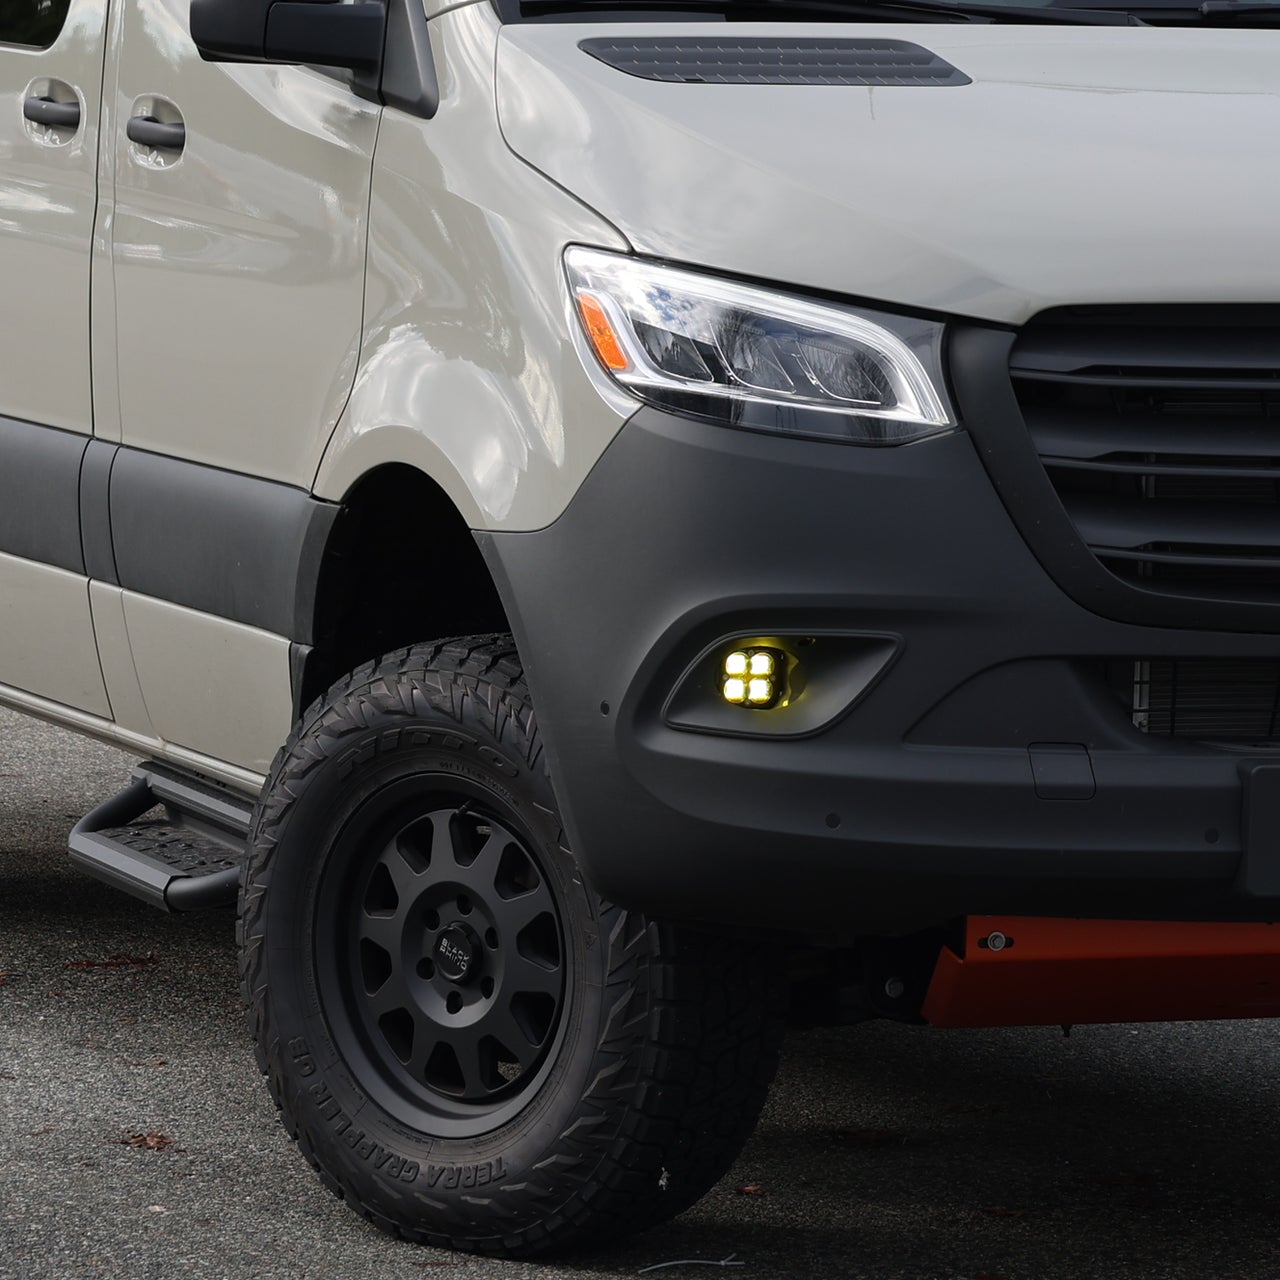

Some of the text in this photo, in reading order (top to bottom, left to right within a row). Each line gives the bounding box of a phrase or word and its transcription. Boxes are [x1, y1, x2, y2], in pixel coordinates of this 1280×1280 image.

[337, 725, 519, 781] NITTO
[440, 945, 467, 970] RHINO
[442, 938, 469, 960] BLACK
[308, 1079, 420, 1183] GRAPPLER
[427, 1157, 507, 1189] TERRA
